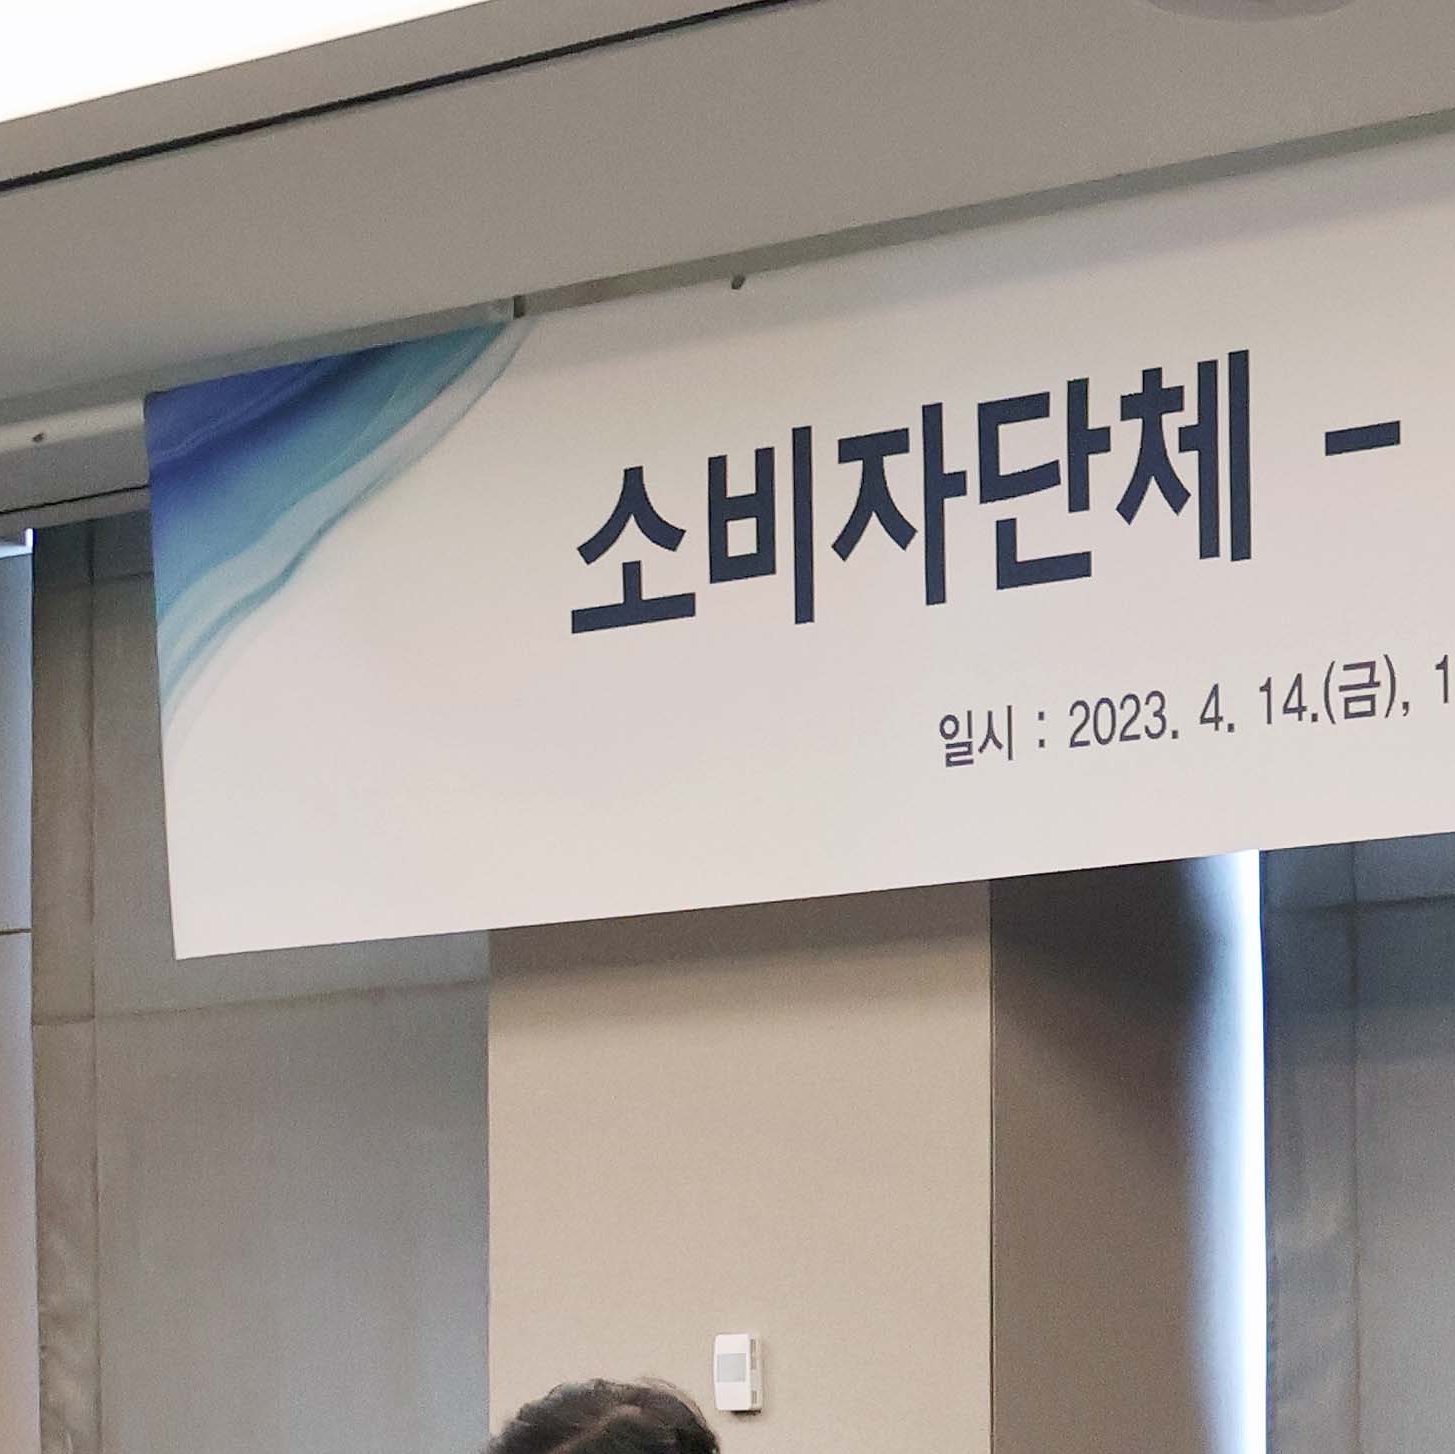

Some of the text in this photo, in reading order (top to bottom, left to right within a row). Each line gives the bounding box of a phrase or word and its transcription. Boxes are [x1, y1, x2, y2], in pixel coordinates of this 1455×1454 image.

[570, 349, 1252, 635] 소비자단체
[939, 704, 1014, 768] 일시
[1069, 690, 1179, 749] 2023.
[1199, 683, 1235, 734] 4.
